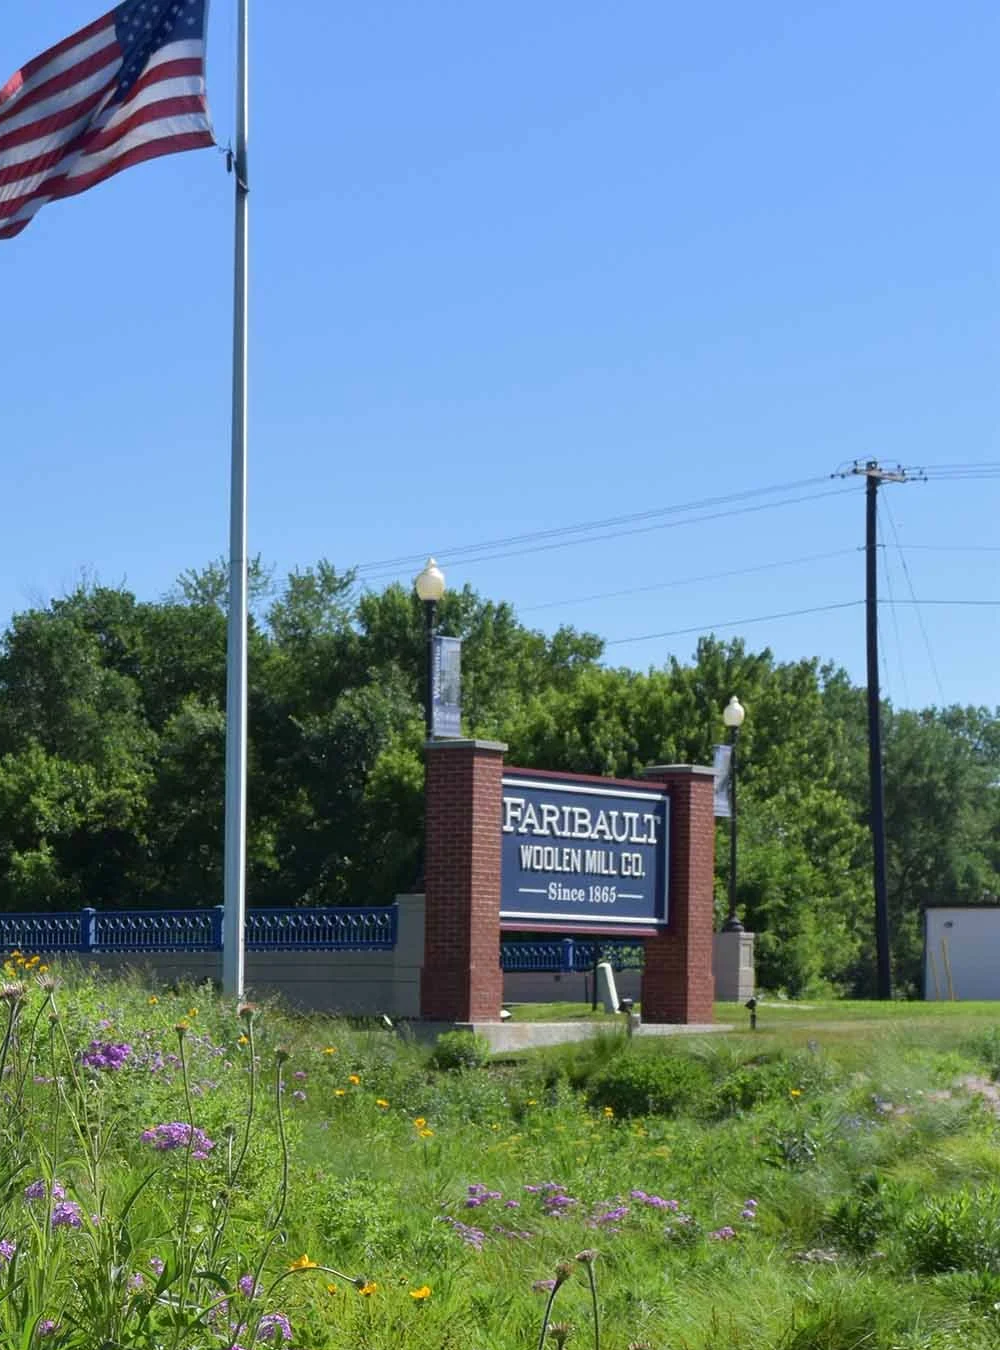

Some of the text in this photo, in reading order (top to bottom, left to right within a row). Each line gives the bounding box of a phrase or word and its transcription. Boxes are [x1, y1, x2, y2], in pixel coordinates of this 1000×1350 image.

[502, 797, 661, 844] FARIBAULT
[520, 844, 646, 877] WOOLEN MILL CO.
[548, 882, 617, 903] Since 1865
